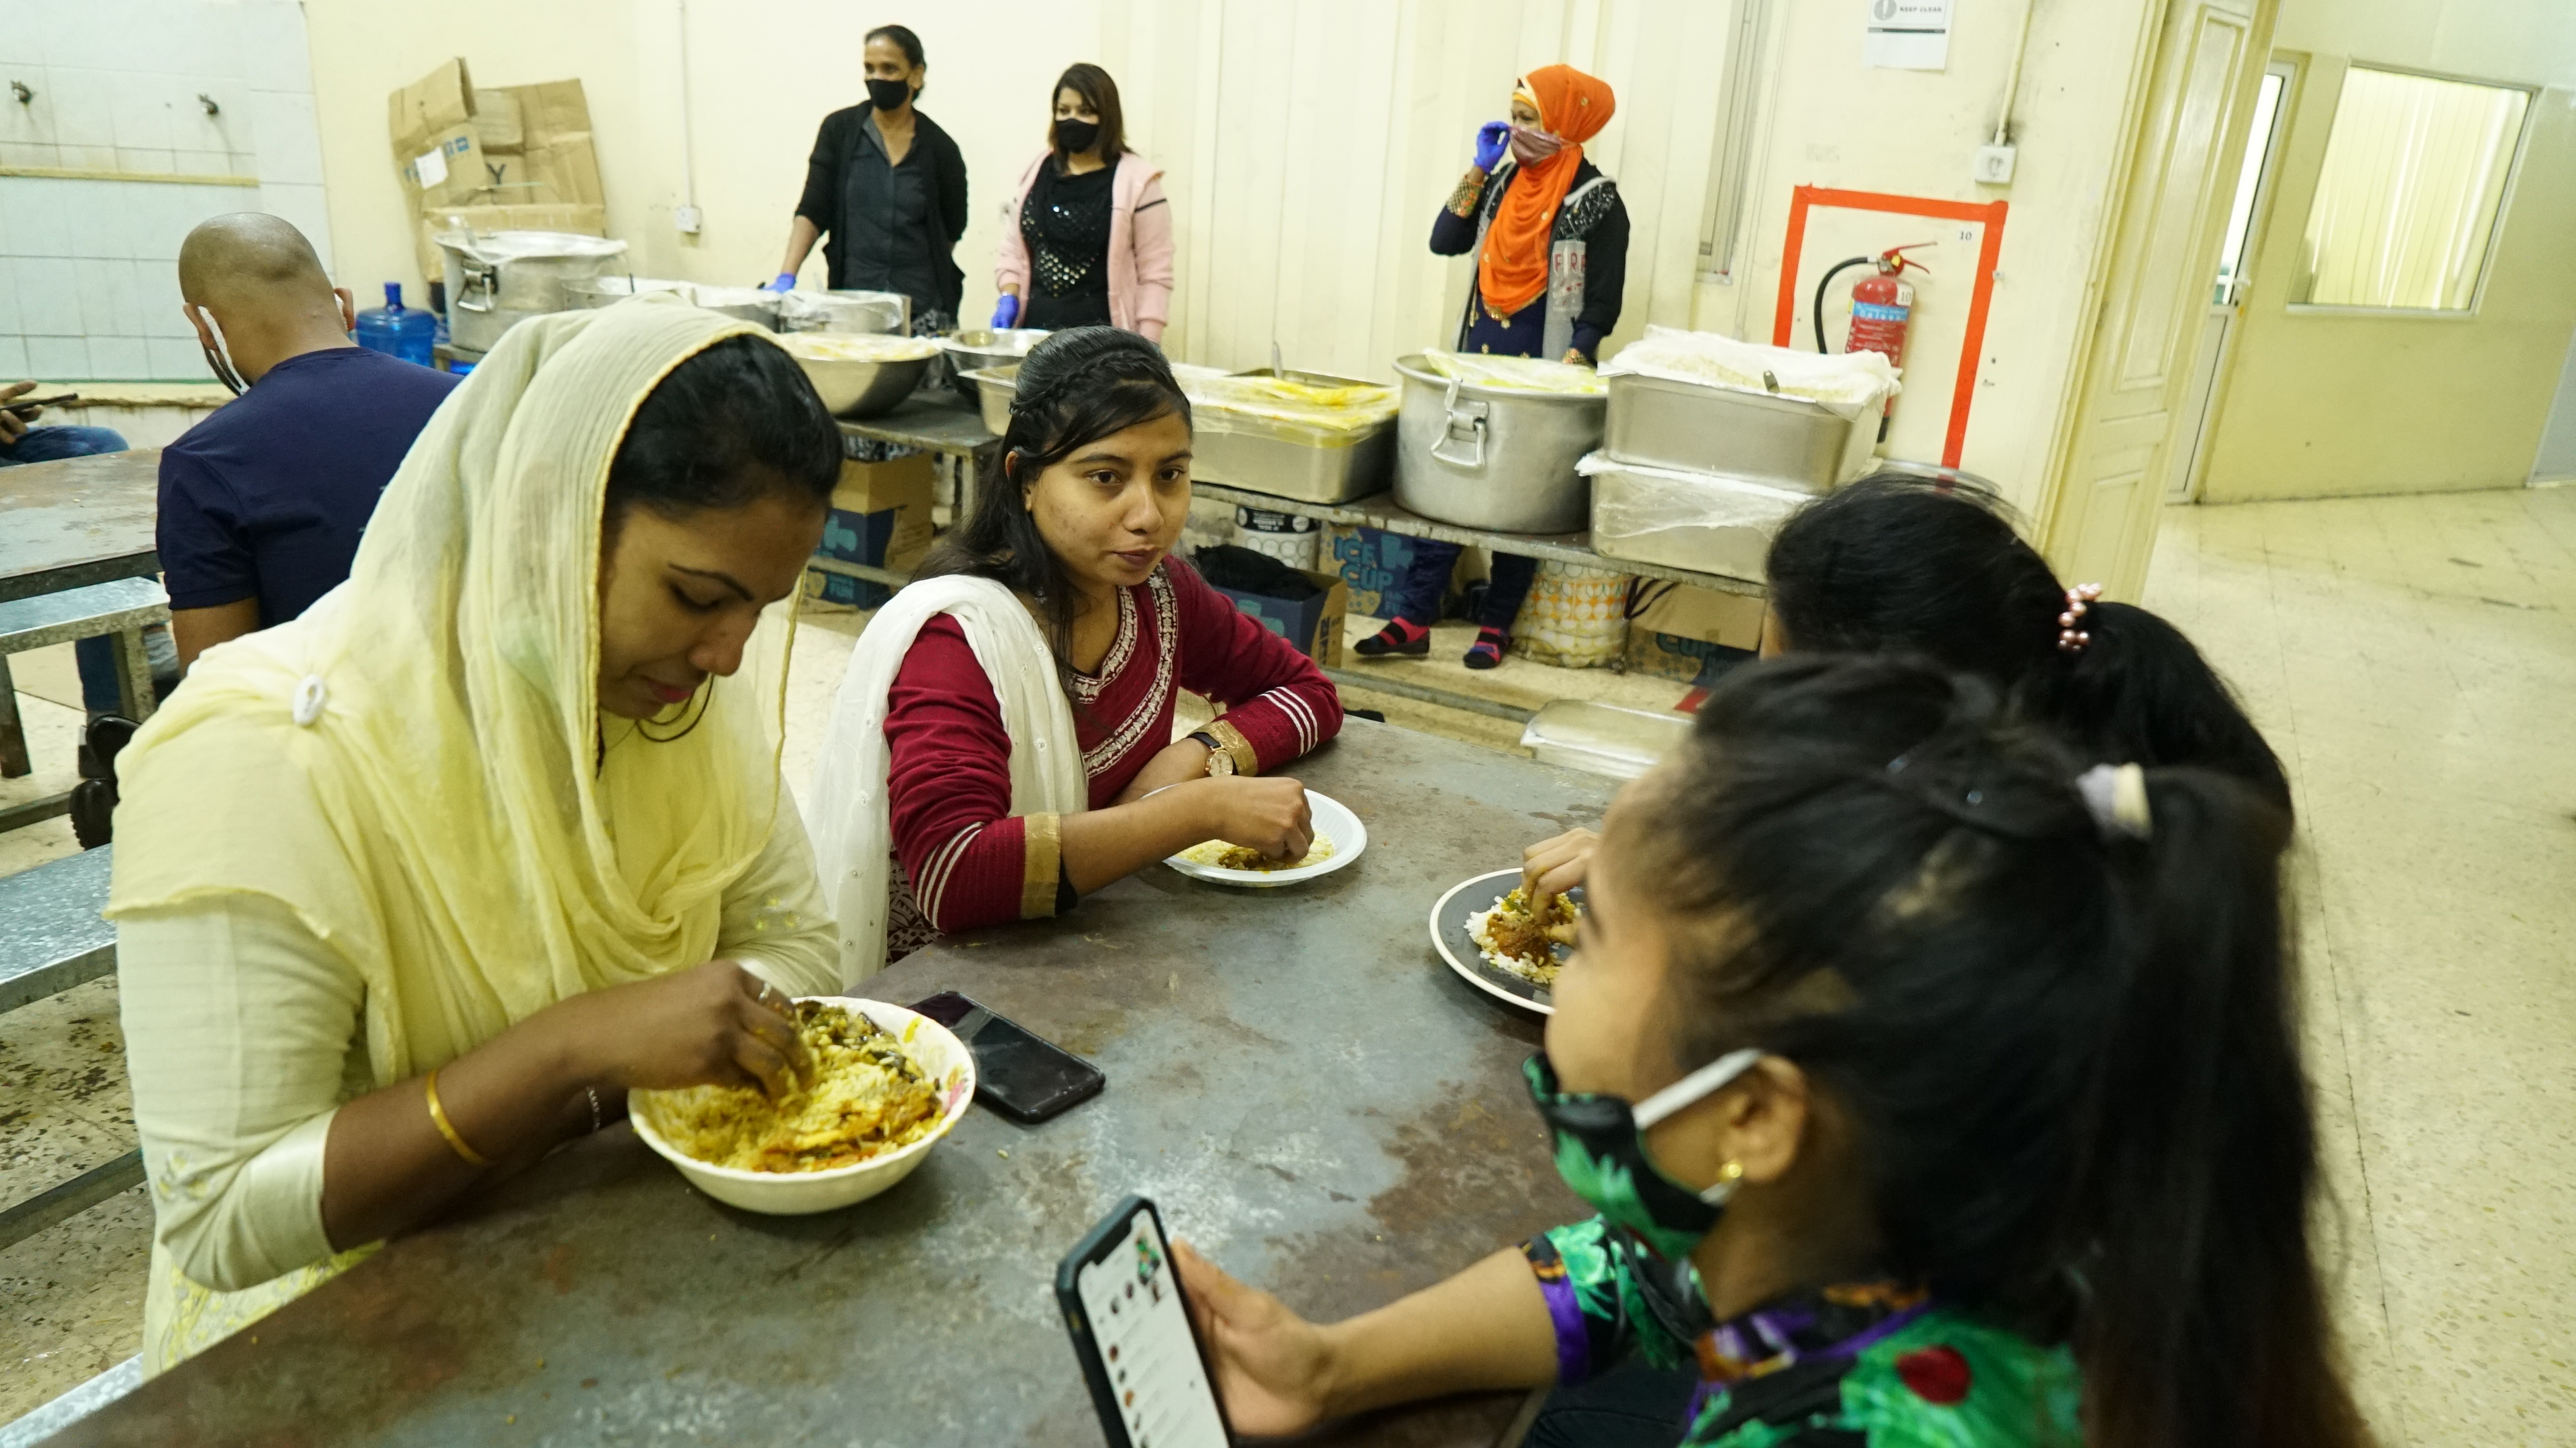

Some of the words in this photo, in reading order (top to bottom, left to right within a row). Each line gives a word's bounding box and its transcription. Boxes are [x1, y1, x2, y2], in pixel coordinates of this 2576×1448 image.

[1959, 231, 1972, 241] 10
[1901, 291, 1912, 302] 10
[1334, 536, 1375, 567] ICE
[1341, 562, 1394, 592] CUP
